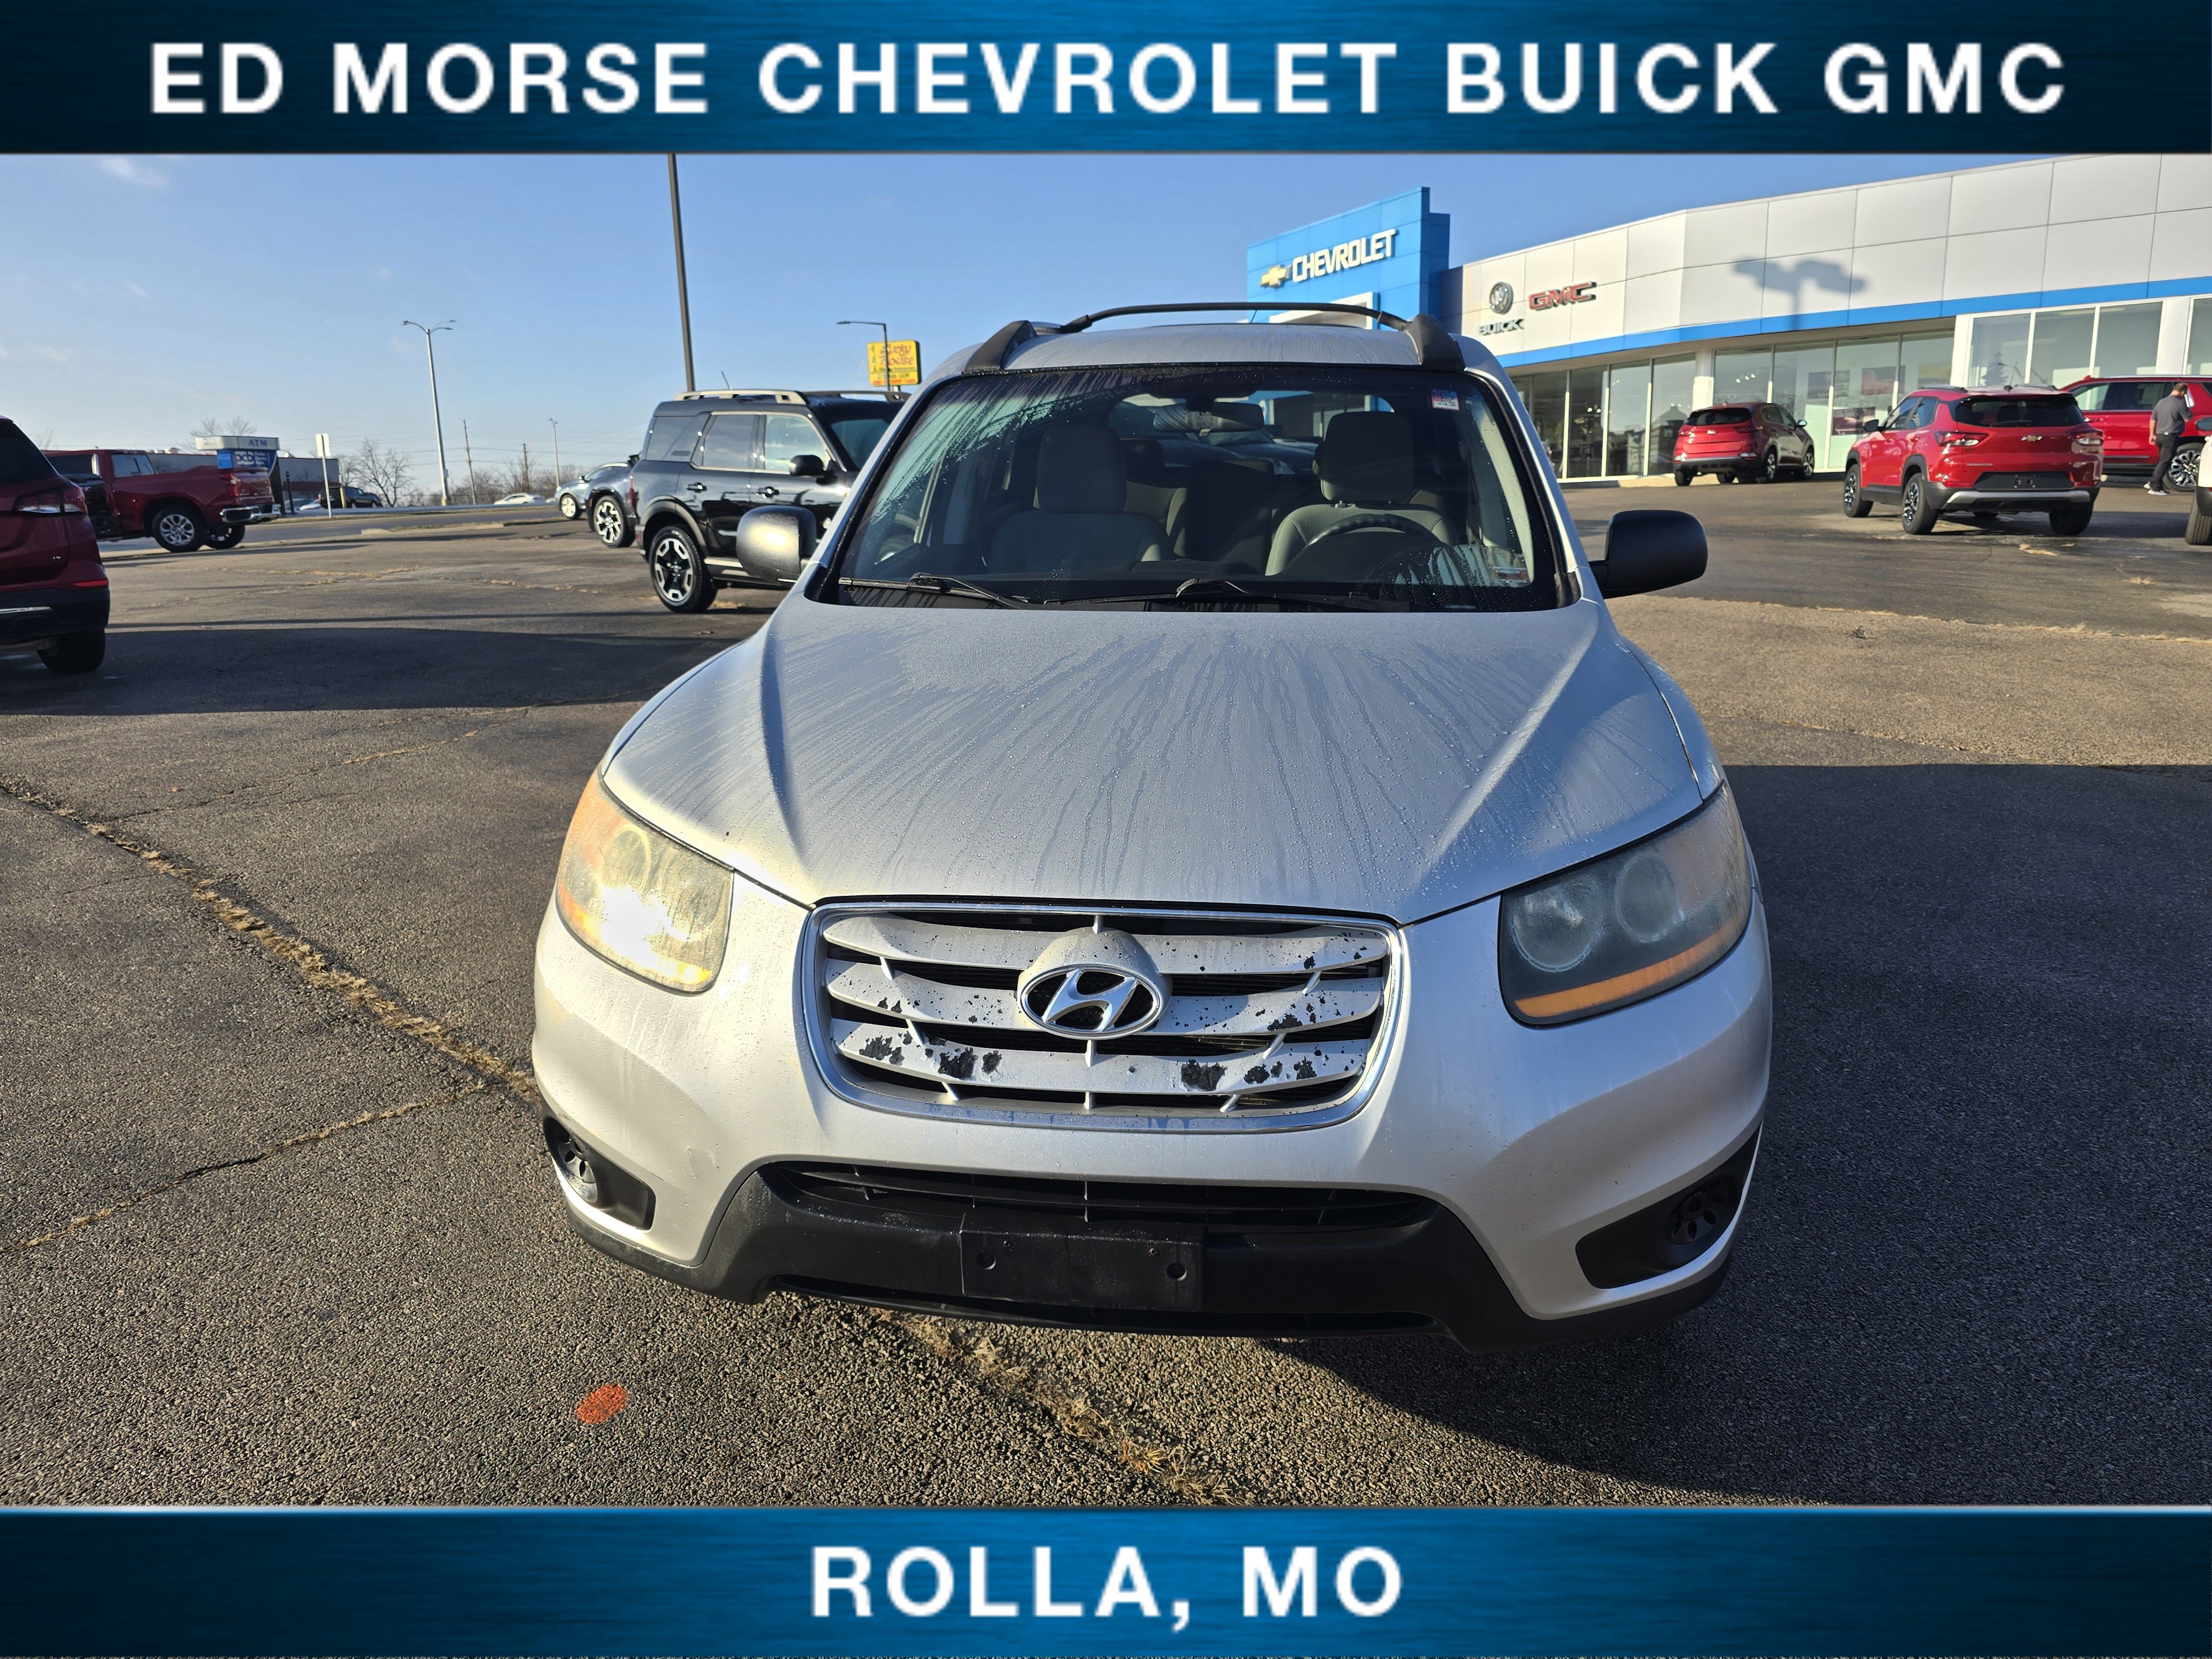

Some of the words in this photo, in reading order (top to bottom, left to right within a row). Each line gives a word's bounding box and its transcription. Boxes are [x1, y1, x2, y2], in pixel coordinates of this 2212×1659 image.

[1292, 228, 1397, 283] CHEVROLET
[1528, 281, 1597, 311] GMC
[1479, 319, 1525, 336] BUICK
[249, 439, 268, 447] ATM
